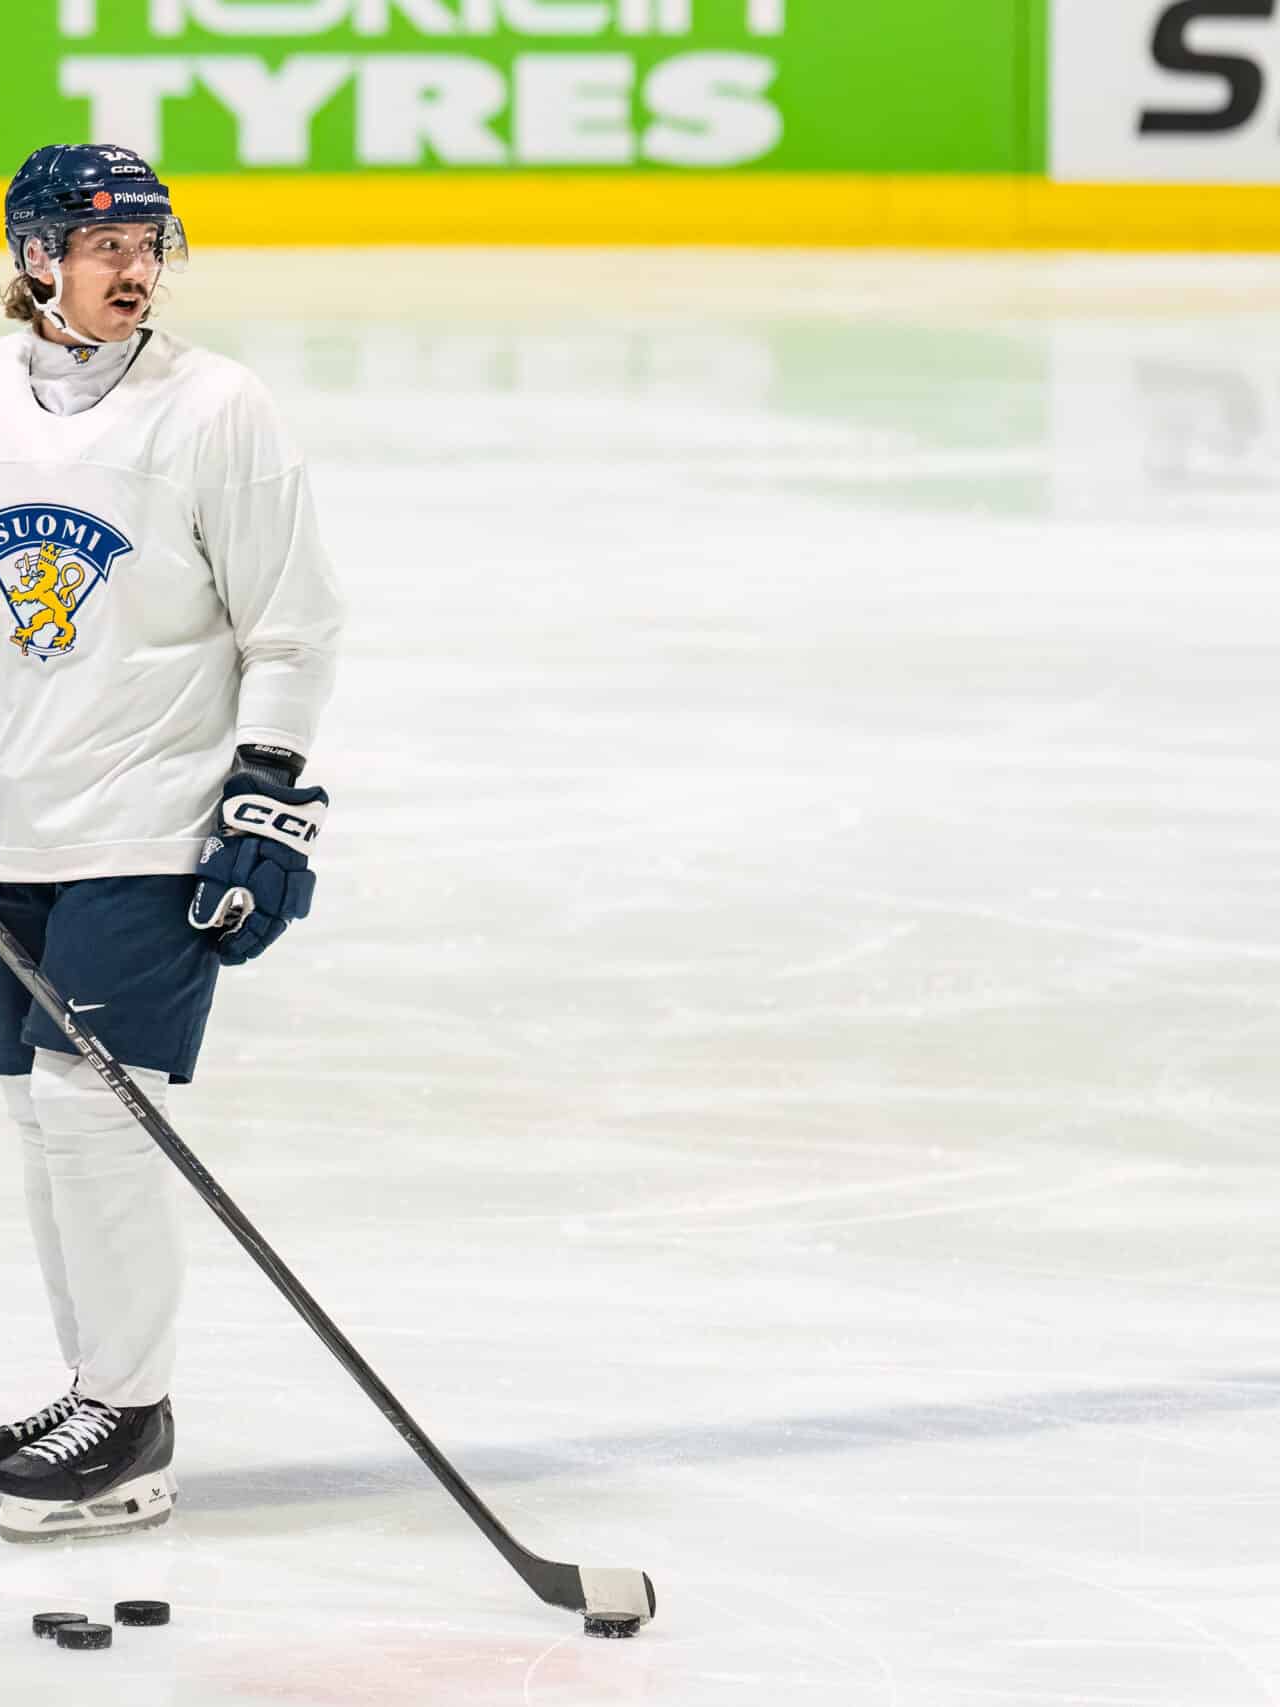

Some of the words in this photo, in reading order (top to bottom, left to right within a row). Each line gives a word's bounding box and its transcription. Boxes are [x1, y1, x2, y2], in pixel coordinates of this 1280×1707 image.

[58, 53, 786, 168] TYRES
[111, 165, 146, 175] CCM
[114, 191, 170, 206] Pihlajalin
[12, 209, 35, 220] CCM
